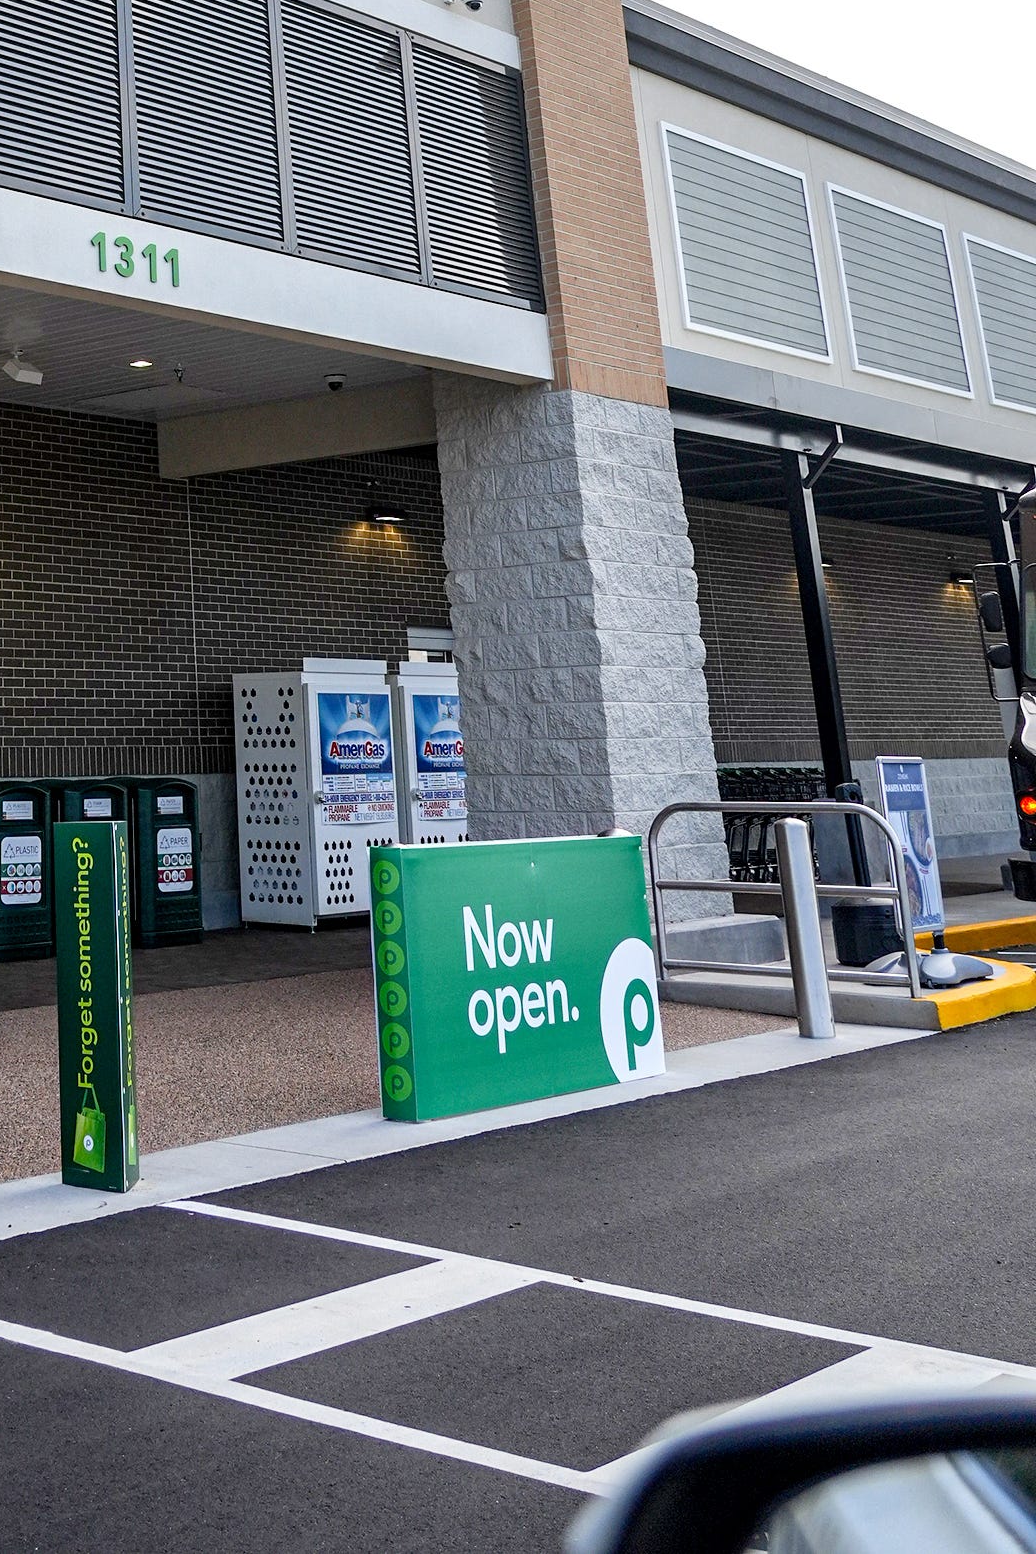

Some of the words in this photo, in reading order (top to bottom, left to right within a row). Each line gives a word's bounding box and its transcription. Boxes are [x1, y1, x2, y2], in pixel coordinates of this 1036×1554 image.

[91, 231, 180, 287] 1311
[329, 741, 385, 758] AmeriGas
[424, 740, 464, 757] AmeriG
[328, 804, 358, 813] FLAMMABLE
[328, 813, 351, 822] PROPANE
[170, 836, 189, 846] PAPER
[15, 845, 39, 855] PLASTIC
[72, 837, 94, 991] something?
[462, 904, 554, 972] Now
[468, 979, 580, 1054] open.
[77, 999, 98, 1089] Forget
